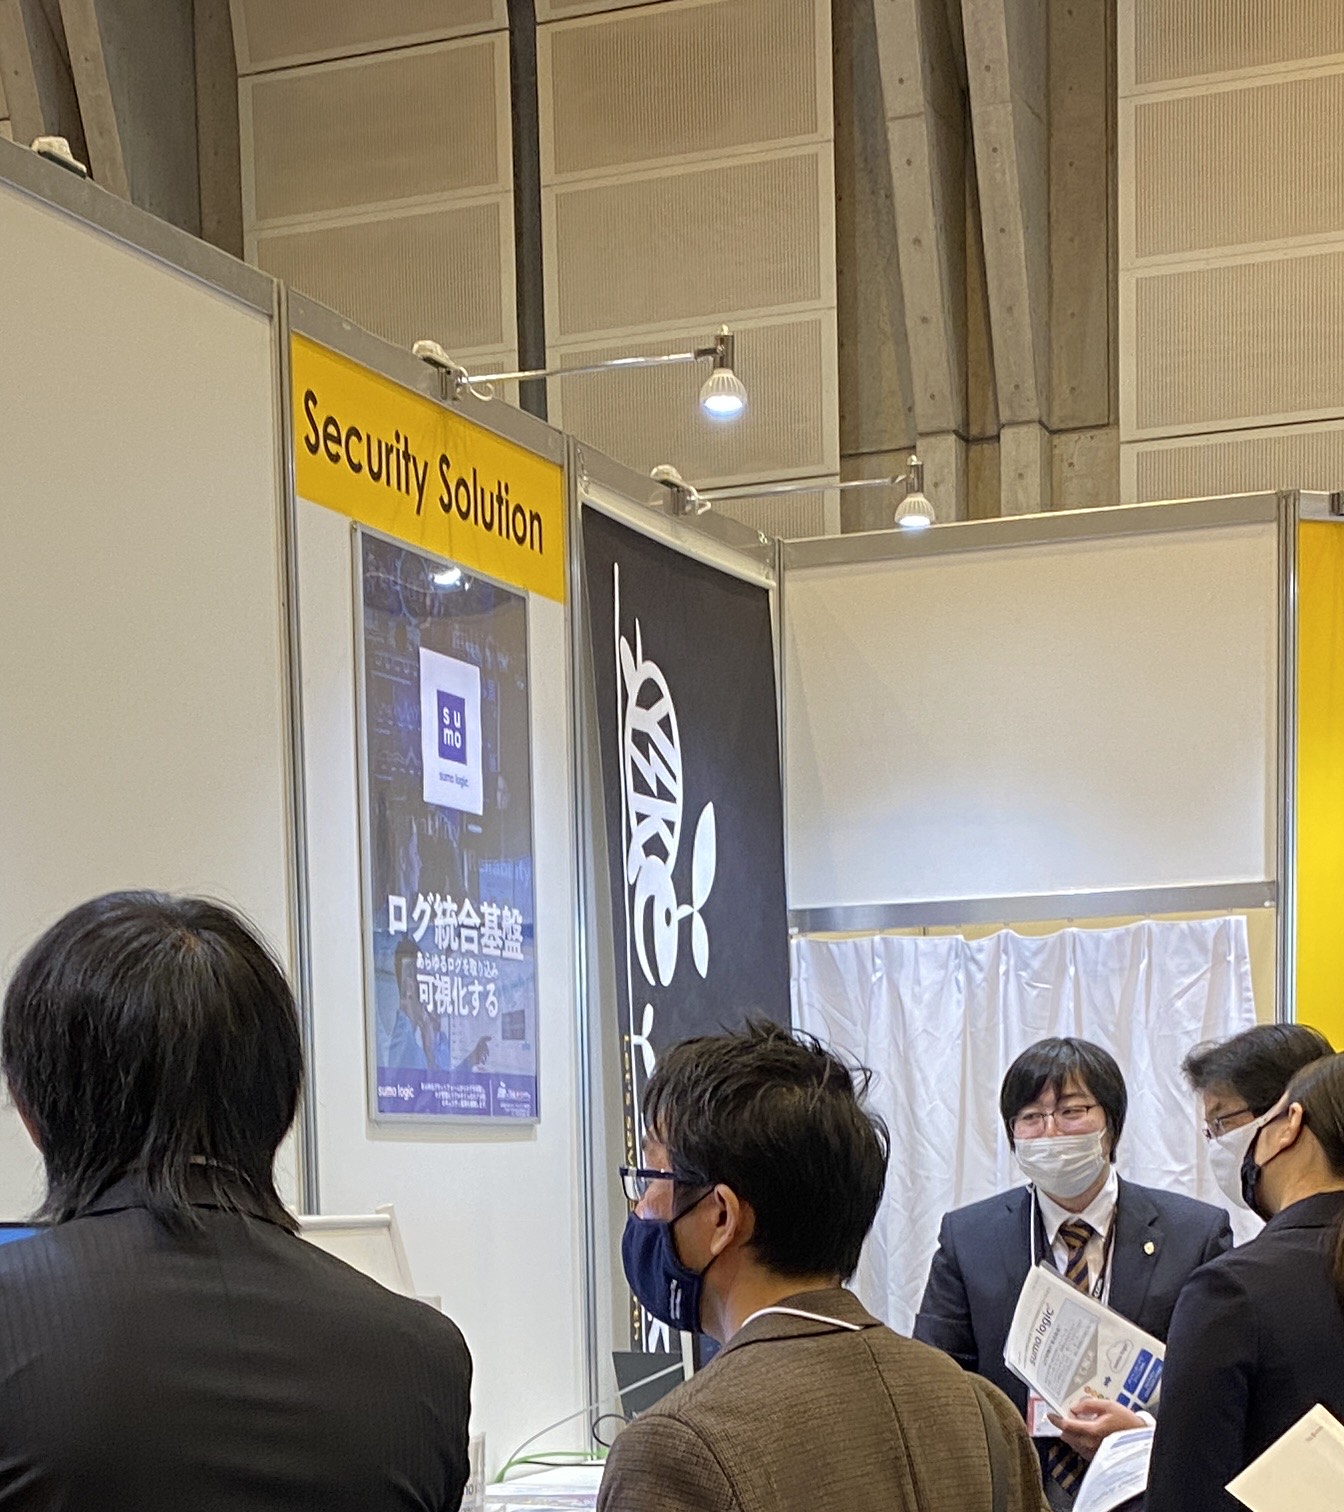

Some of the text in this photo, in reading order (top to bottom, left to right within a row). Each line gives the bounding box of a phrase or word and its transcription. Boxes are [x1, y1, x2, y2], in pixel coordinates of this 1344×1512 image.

[304, 389, 543, 554] Security Solution
[388, 892, 524, 961] ログ統合基盤
[416, 951, 498, 979] あらゆるログを取り込み
[416, 973, 499, 1018] 可視化する
[1029, 1337, 1042, 1367] sumo
[1036, 1306, 1055, 1337] logic
